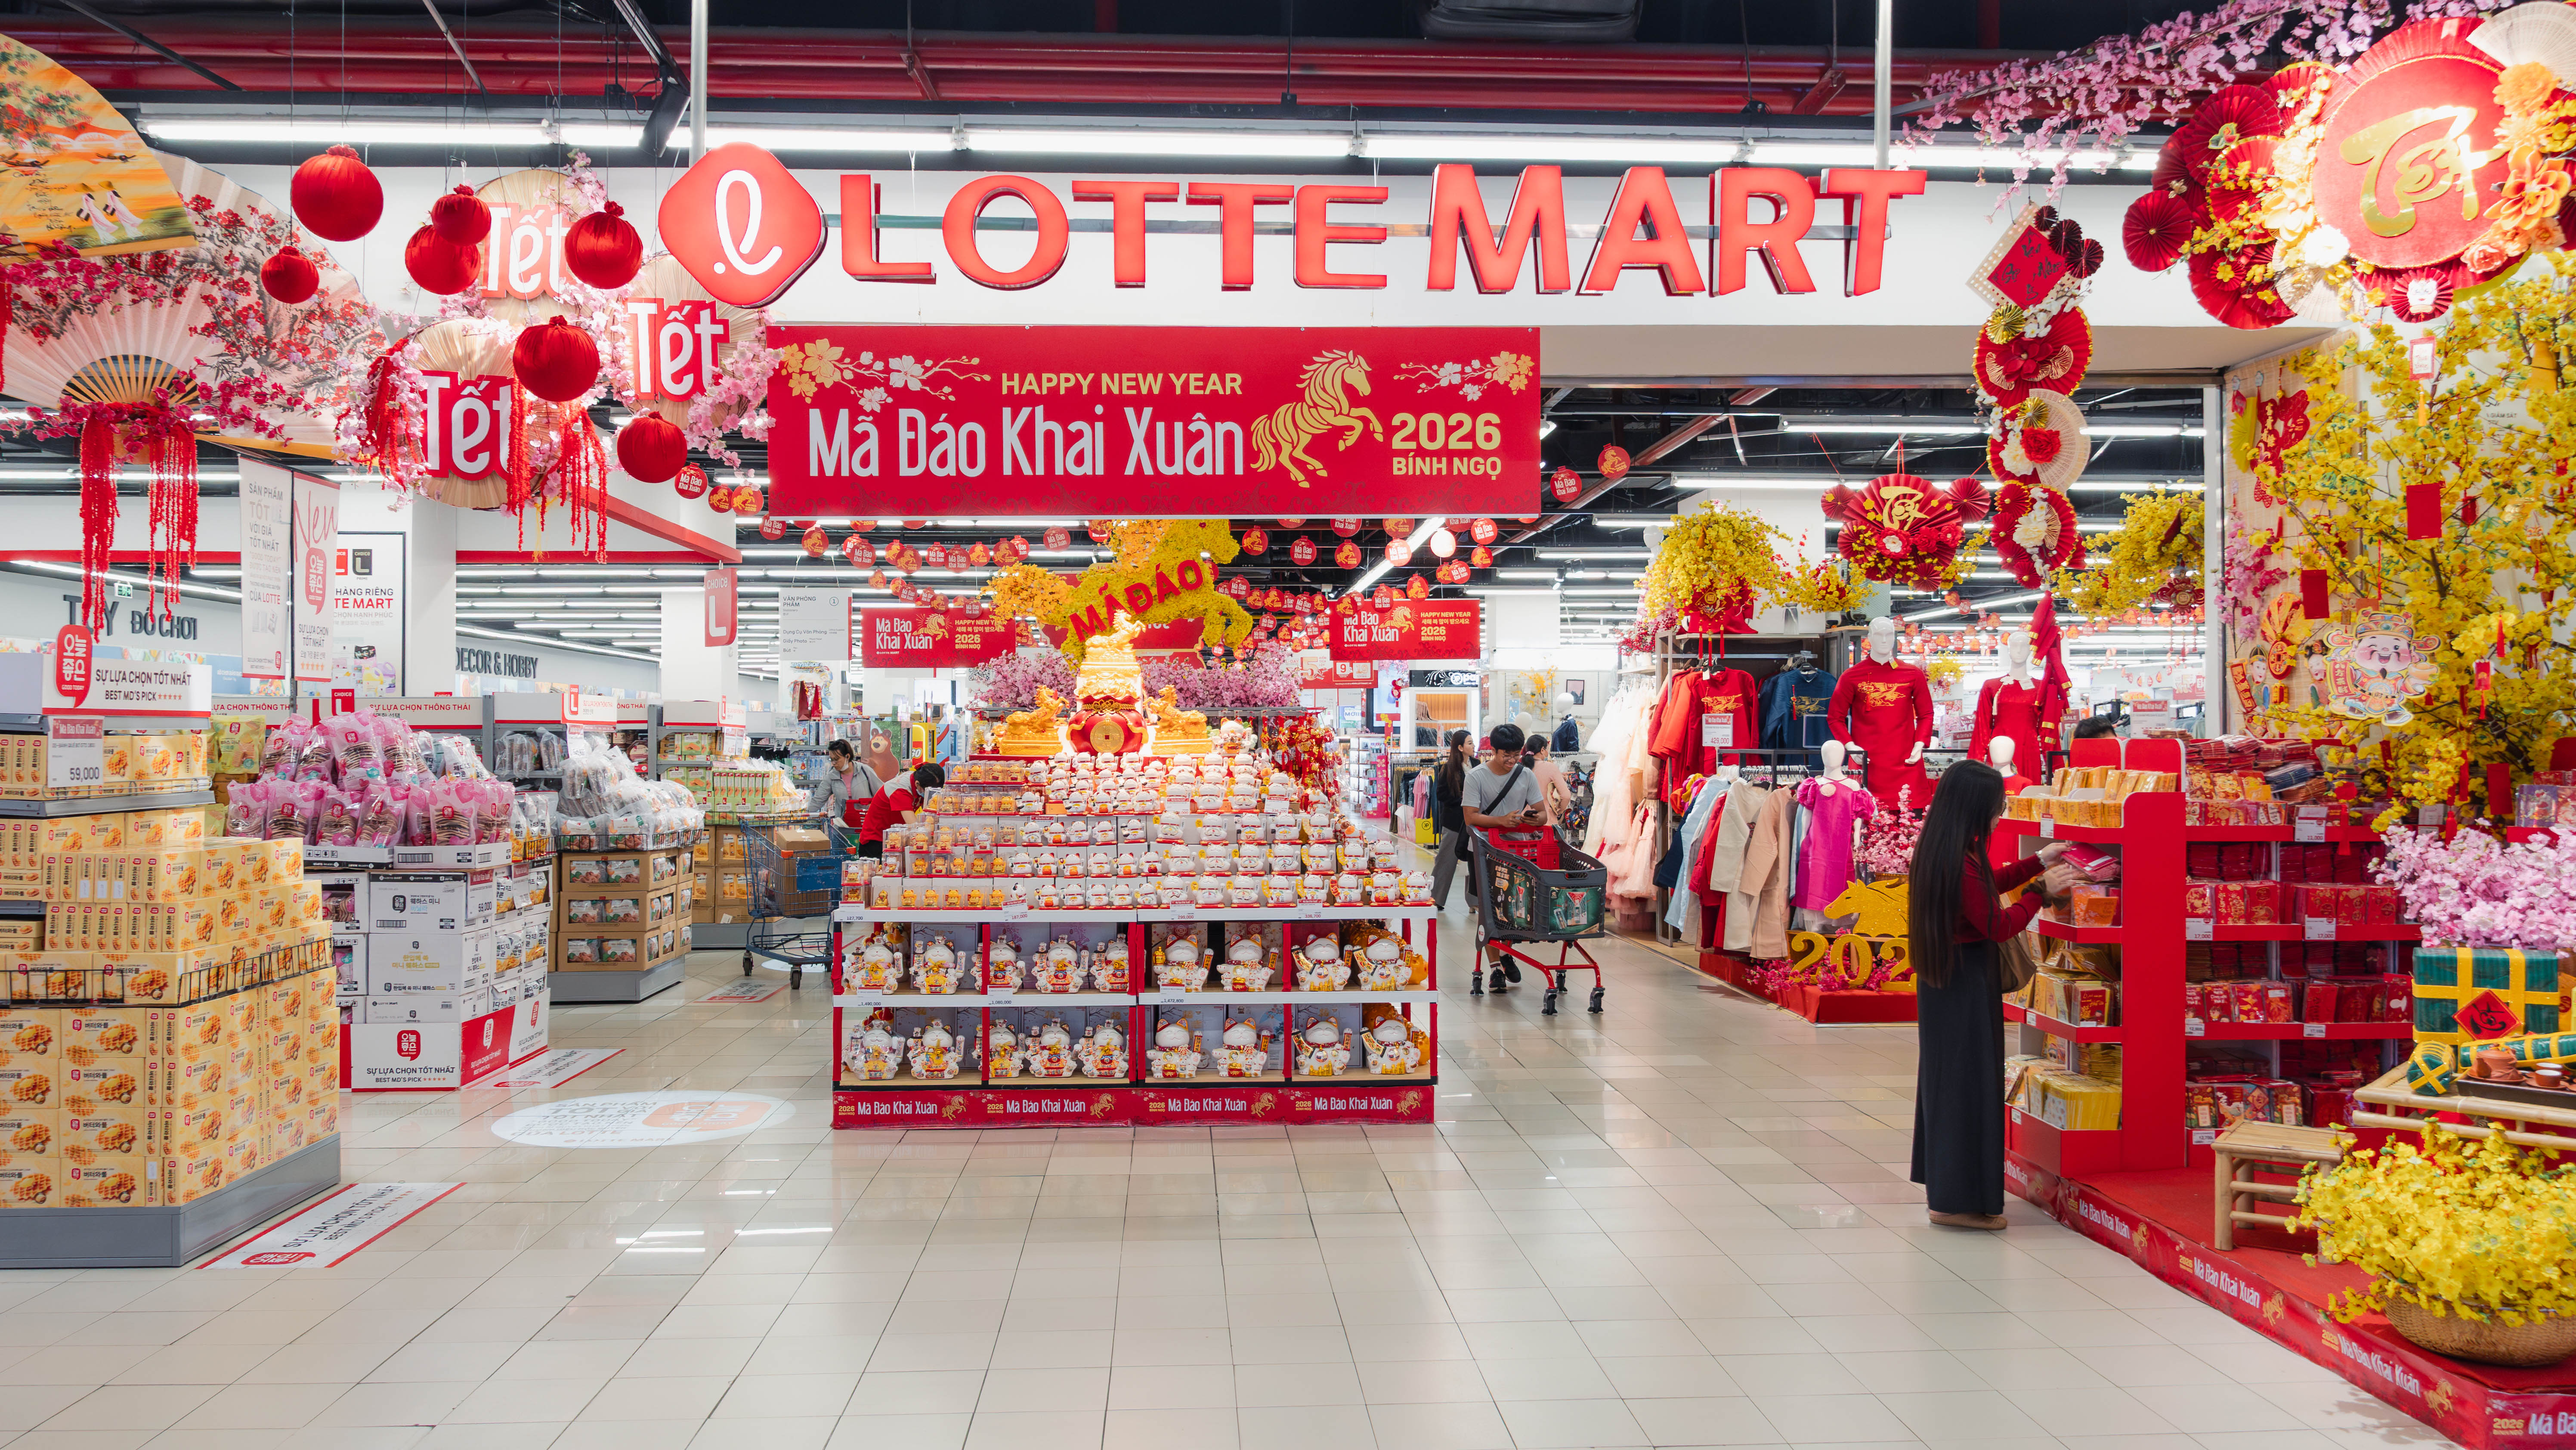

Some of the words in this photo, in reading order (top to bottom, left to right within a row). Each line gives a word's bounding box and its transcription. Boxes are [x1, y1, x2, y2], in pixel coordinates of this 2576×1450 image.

[840, 174, 1388, 291] LOTTE
[1429, 164, 1925, 297] MART
[628, 302, 724, 397] Tết
[1002, 373, 1094, 395] HAPPY
[1101, 373, 1163, 394] NEW
[1167, 373, 1242, 394] YEAR
[1392, 412, 1501, 450] 2026
[809, 409, 878, 476] Mã
[899, 409, 986, 477] Đáo
[1002, 404, 1104, 475] Khai
[1123, 407, 1243, 476] Xuân
[1393, 452, 1447, 475] BÍNH
[1453, 457, 1501, 480] NGỌ
[250, 499, 270, 521] TỐT
[250, 522, 260, 534] VỚI
[262, 524, 272, 536] GIÁ
[250, 536, 261, 548] TỐT
[263, 539, 279, 552] NHẤT
[335, 586, 362, 596] HÀNG
[365, 586, 393, 596] RIÊNG
[706, 577, 728, 589] CHOICE
[250, 589, 262, 601] CỦA
[263, 594, 280, 604] LOTTE
[353, 598, 393, 609] MART
[1069, 582, 1119, 642] MÃ
[1124, 559, 1204, 615] ĐÁO
[63, 595, 120, 636] TY
[708, 595, 727, 638] L
[876, 617, 891, 632] Mã
[894, 617, 912, 632] Đáo
[1421, 626, 1446, 635] 2026
[876, 633, 900, 650] Khai
[904, 634, 932, 650] Xuân
[456, 647, 492, 674] DECOR
[494, 652, 502, 675] &
[504, 653, 538, 679] HOBBY
[1339, 663, 1347, 673] 9
[96, 669, 108, 685] SỰ
[109, 669, 127, 686] LỰA
[129, 671, 152, 687] CHỌN
[154, 669, 170, 684] TỐT
[171, 672, 192, 686] NHẤT
[105, 691, 121, 701] BEST
[123, 691, 140, 701] MD'S
[141, 691, 157, 701] PICK
[226, 703, 249, 712] CHỌN
[251, 702, 278, 711] THÔNG
[70, 767, 99, 782] 59,000
[479, 902, 492, 912] 59,000
[857, 1102, 871, 1115] Mã
[874, 1102, 891, 1115] Đáo
[893, 1101, 913, 1115] Khai
[915, 1101, 937, 1114] Xuân
[2194, 1257, 2204, 1281] Mã
[2205, 1263, 2218, 1287] Đáo
[2220, 1271, 2238, 1298] Khai
[2239, 1280, 2261, 1309] Xuân
[2493, 1418, 2524, 1429] 2026
[2529, 1413, 2553, 1435] Mã
